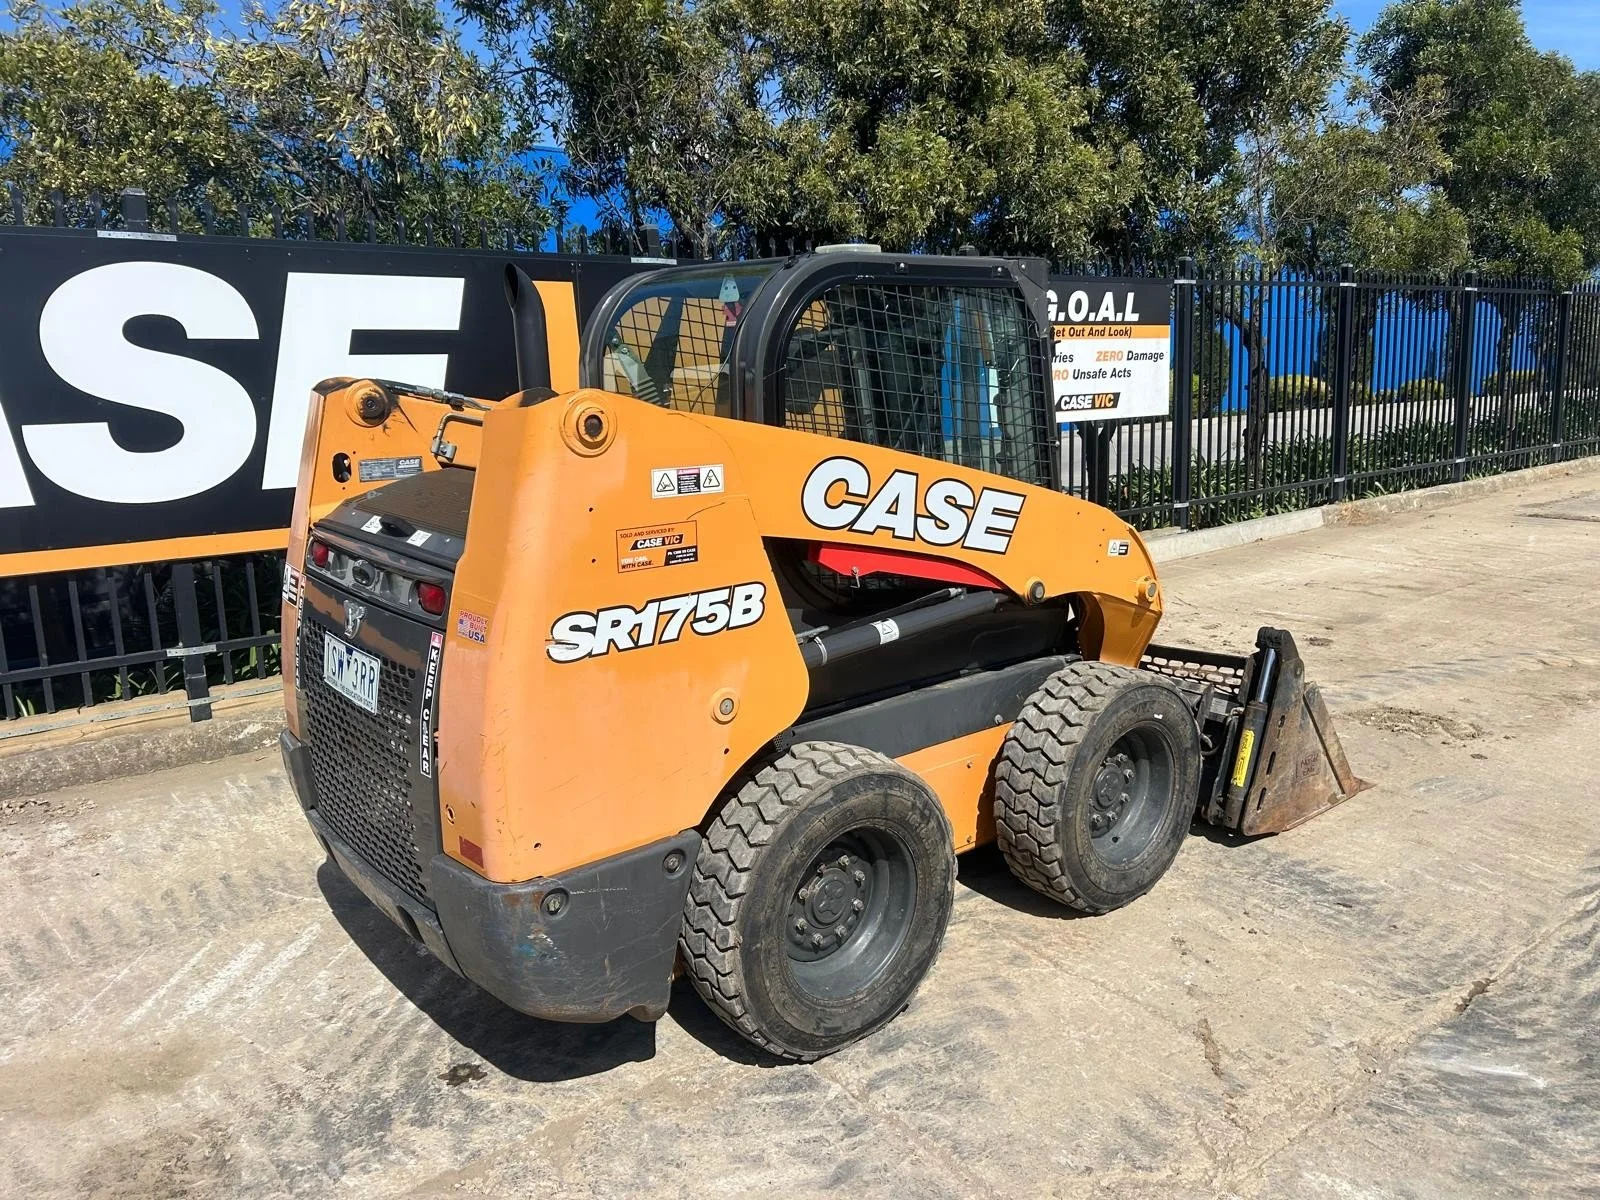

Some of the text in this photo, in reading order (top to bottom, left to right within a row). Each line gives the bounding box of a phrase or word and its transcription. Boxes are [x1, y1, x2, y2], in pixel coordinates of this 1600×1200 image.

[1068, 327, 1086, 338] Out
[1088, 326, 1106, 337] And
[1108, 326, 1132, 338] Look)
[1096, 351, 1124, 362] ZERO
[1126, 350, 1164, 364] Damage
[1072, 368, 1108, 380] Unsafe
[1110, 367, 1132, 379] Acts
[1060, 393, 1115, 410] CASE VIC
[800, 455, 1028, 555] CASE
[636, 536, 681, 549] CASE VIC
[460, 611, 488, 625] PROUDLY
[544, 581, 767, 664] SR175B
[470, 622, 488, 632] BUILT
[468, 630, 486, 643] USA
[425, 647, 442, 700] KEEP
